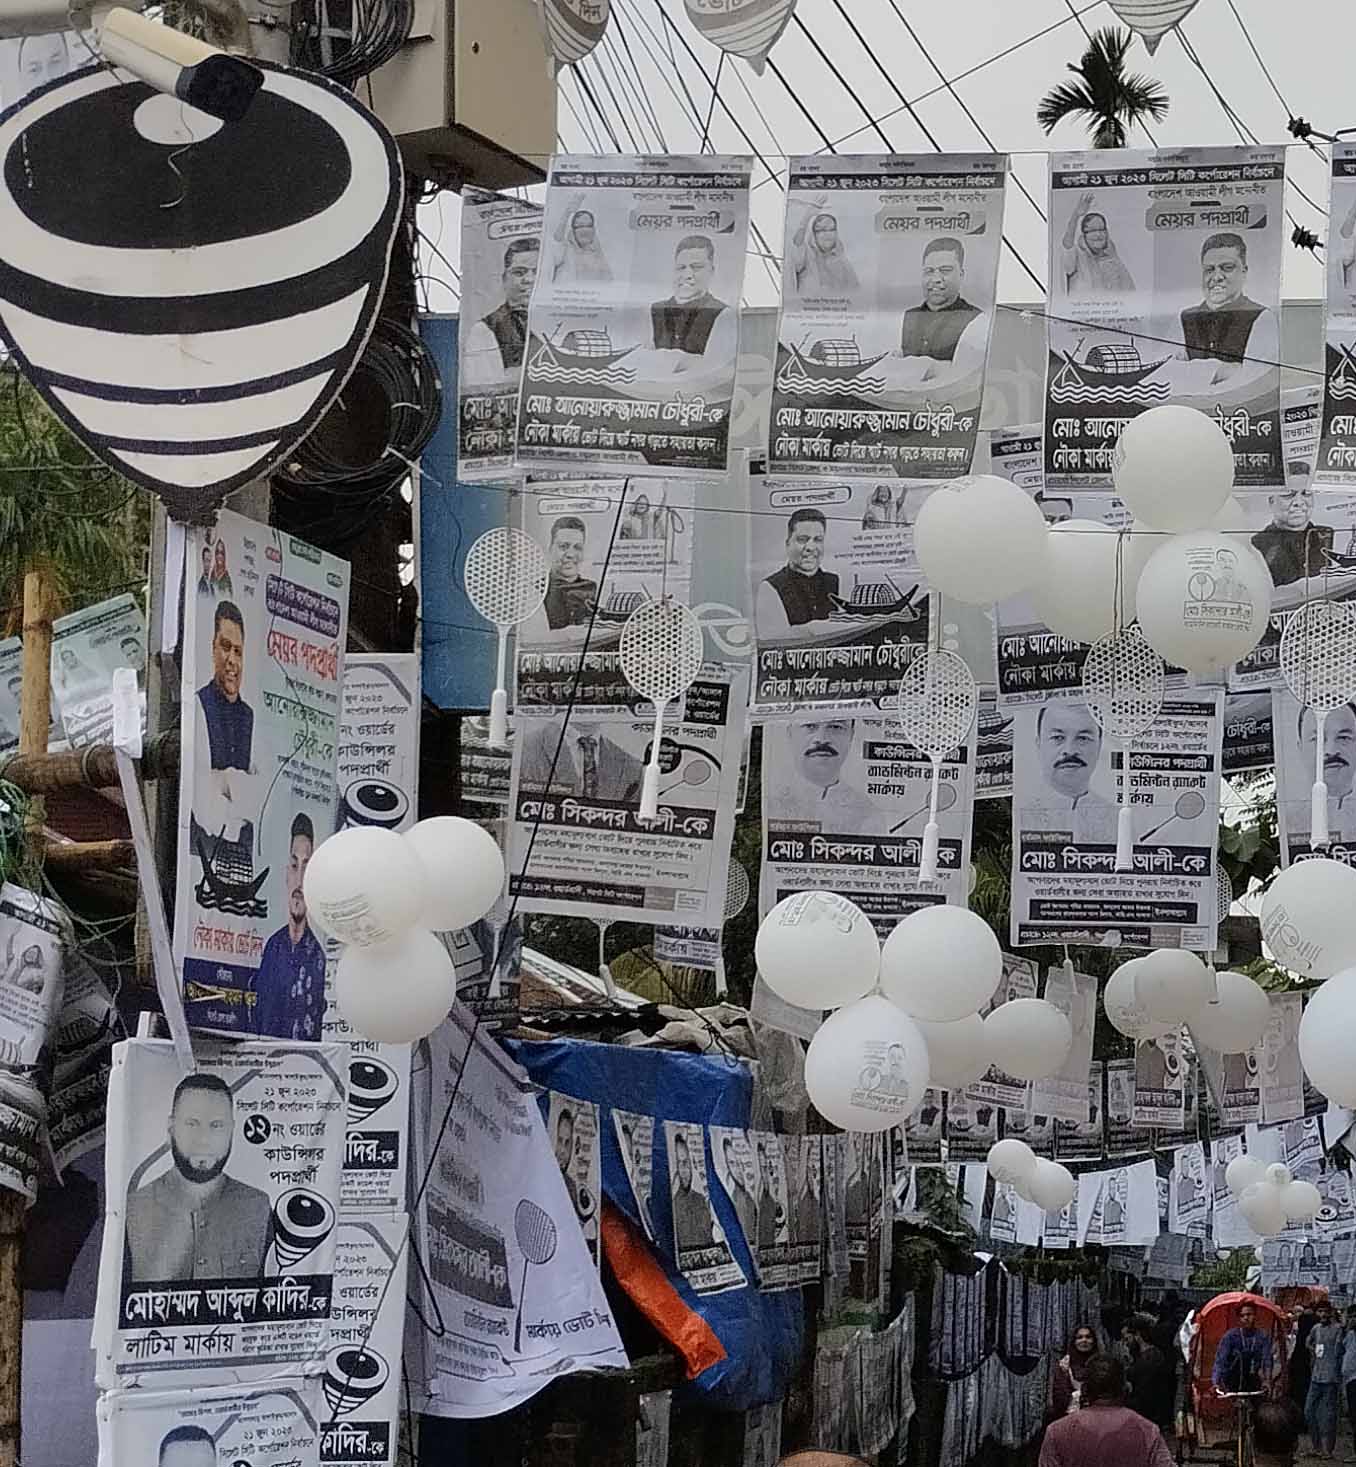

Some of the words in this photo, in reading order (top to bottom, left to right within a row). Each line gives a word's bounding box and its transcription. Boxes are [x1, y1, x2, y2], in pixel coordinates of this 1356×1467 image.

[884, 215, 921, 230] মেয়র
[1155, 211, 1195, 227] মেয়র
[527, 395, 551, 414] মোঃ
[776, 407, 800, 427] মোঃ
[1053, 419, 1080, 437] মোঃ
[525, 419, 550, 442] নৌকা
[775, 432, 800, 456] নৌকা
[1053, 443, 1080, 469] নৌকা
[1002, 635, 1025, 658] মোঃ
[762, 651, 783, 671] মোঃ
[761, 675, 791, 697] নৌকা
[771, 839, 804, 859] মোঃ
[1022, 851, 1056, 869] মোঃ
[1061, 846, 1117, 870] সিকন্দ
[1132, 848, 1207, 871] আলী-কে
[246, 1118, 268, 1139] ১২
[126, 1289, 201, 1322] মোহাম্মদ
[205, 1288, 260, 1322] আব্দুল
[563, 1312, 594, 1336] ভোট
[125, 1331, 175, 1358] লাটিম
[183, 1327, 235, 1354] মার্কায়
